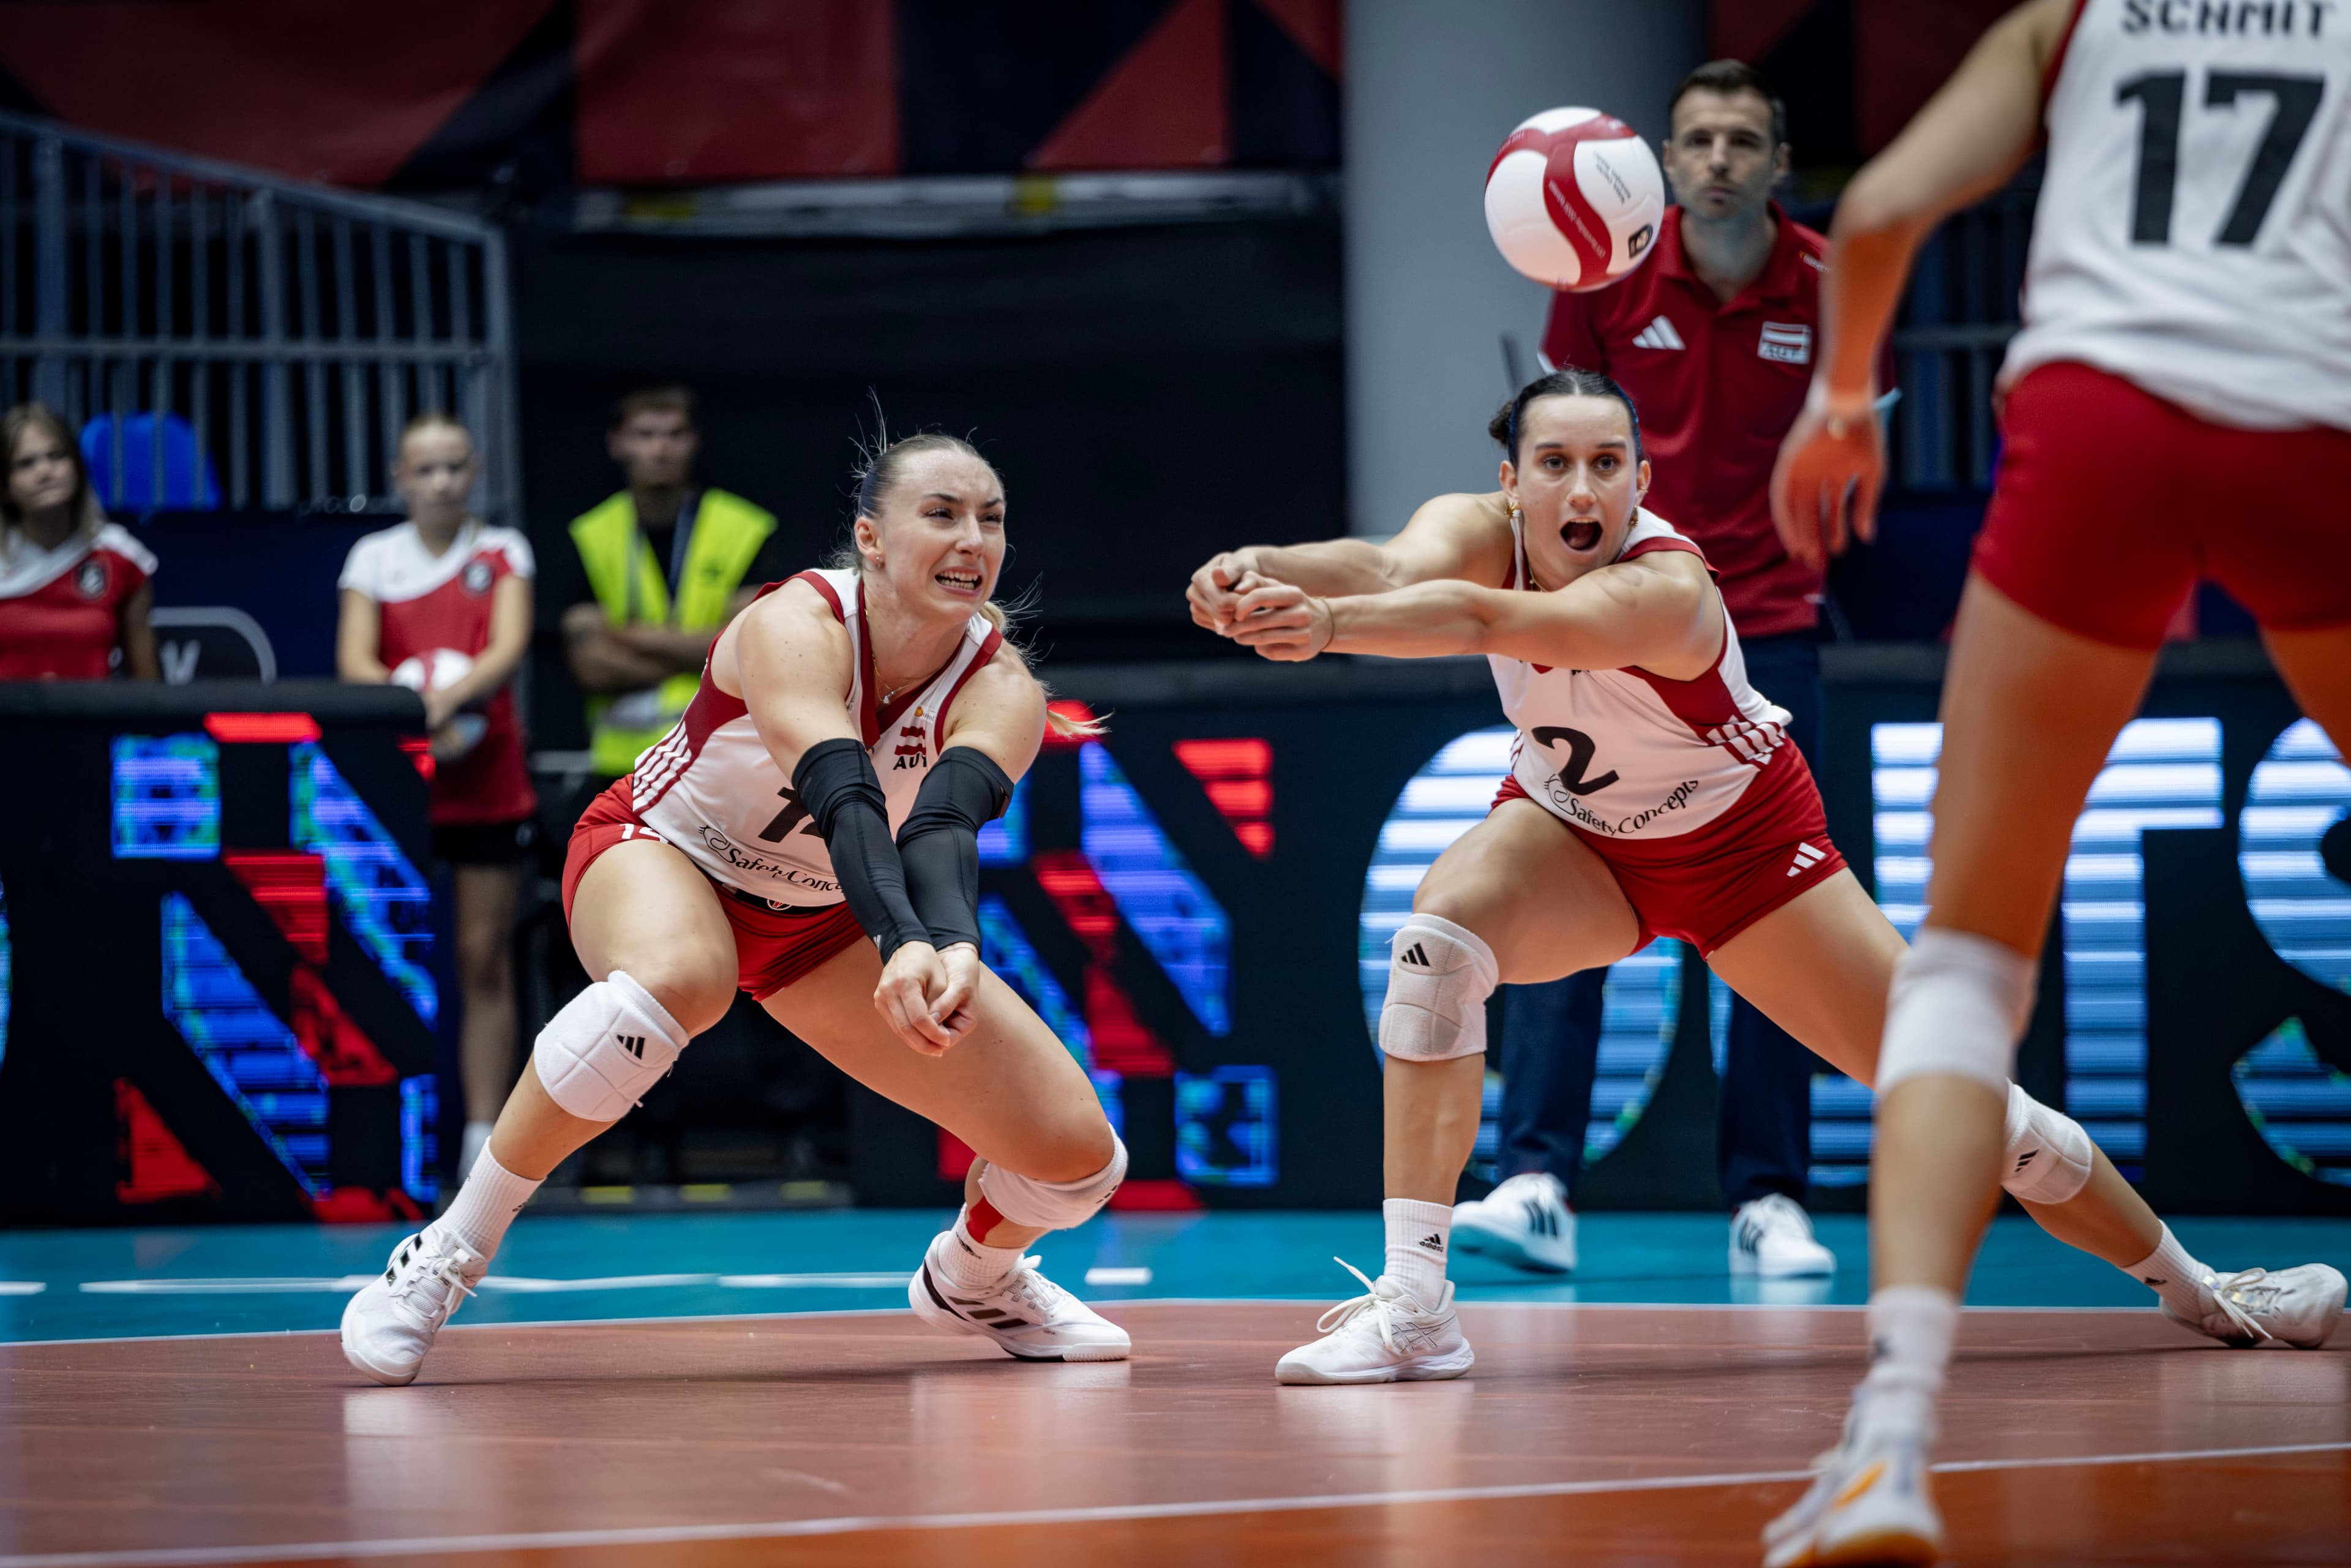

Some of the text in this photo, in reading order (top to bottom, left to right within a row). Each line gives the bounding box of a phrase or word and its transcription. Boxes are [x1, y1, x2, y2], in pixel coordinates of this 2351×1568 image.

[2114, 69, 2325, 248] 17
[1531, 726, 1619, 795] 2
[758, 786, 825, 843] 1
[1419, 1241, 1444, 1252] adidas
